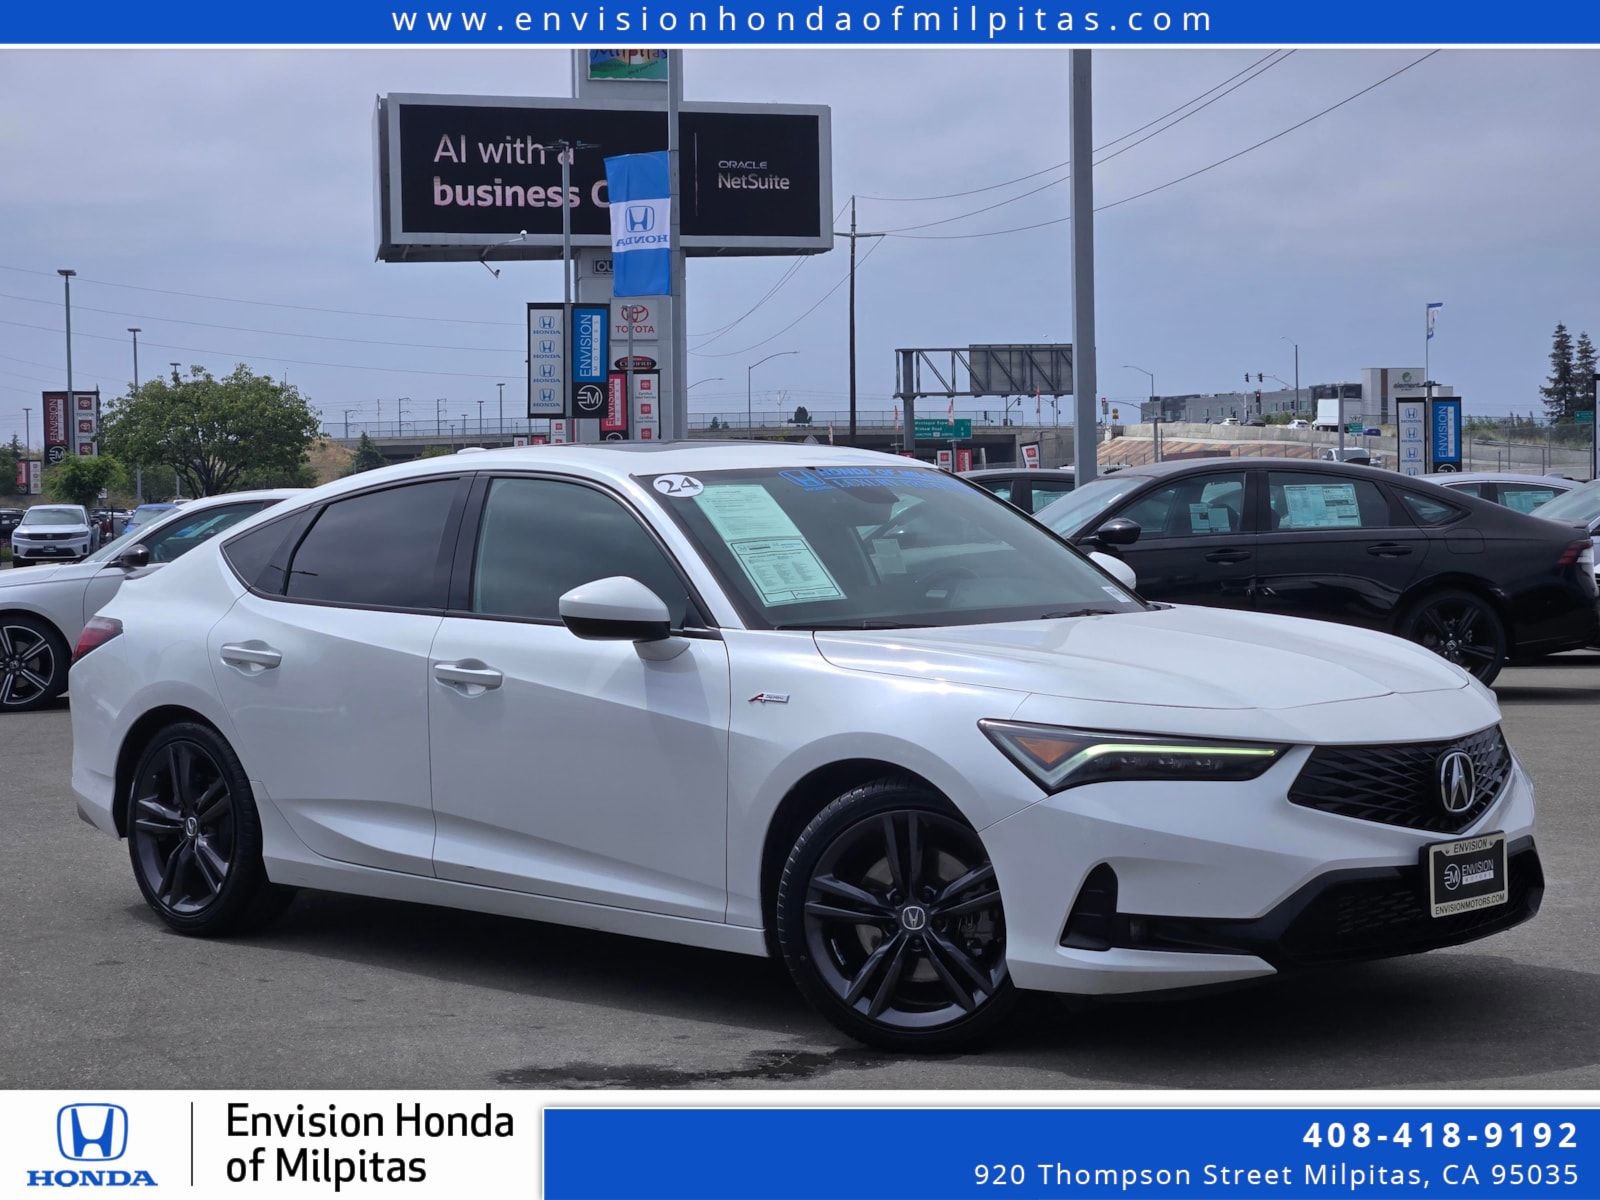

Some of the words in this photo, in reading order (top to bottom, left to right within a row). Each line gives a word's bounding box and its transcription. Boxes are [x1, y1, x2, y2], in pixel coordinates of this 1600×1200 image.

[434, 134, 466, 163] AI
[478, 135, 546, 165] with
[718, 160, 767, 169] ORACLE
[433, 176, 581, 208] business
[718, 173, 790, 190] NetSuite
[580, 314, 591, 376] ENVISION
[49, 398, 58, 441] ENVISION
[1438, 406, 1448, 457] ENVISION
[657, 476, 700, 494] 24
[1454, 839, 1487, 853] ENVISION
[1462, 859, 1494, 876] ENVISION
[1435, 892, 1504, 915] ENVISIONMOTORS.COM
